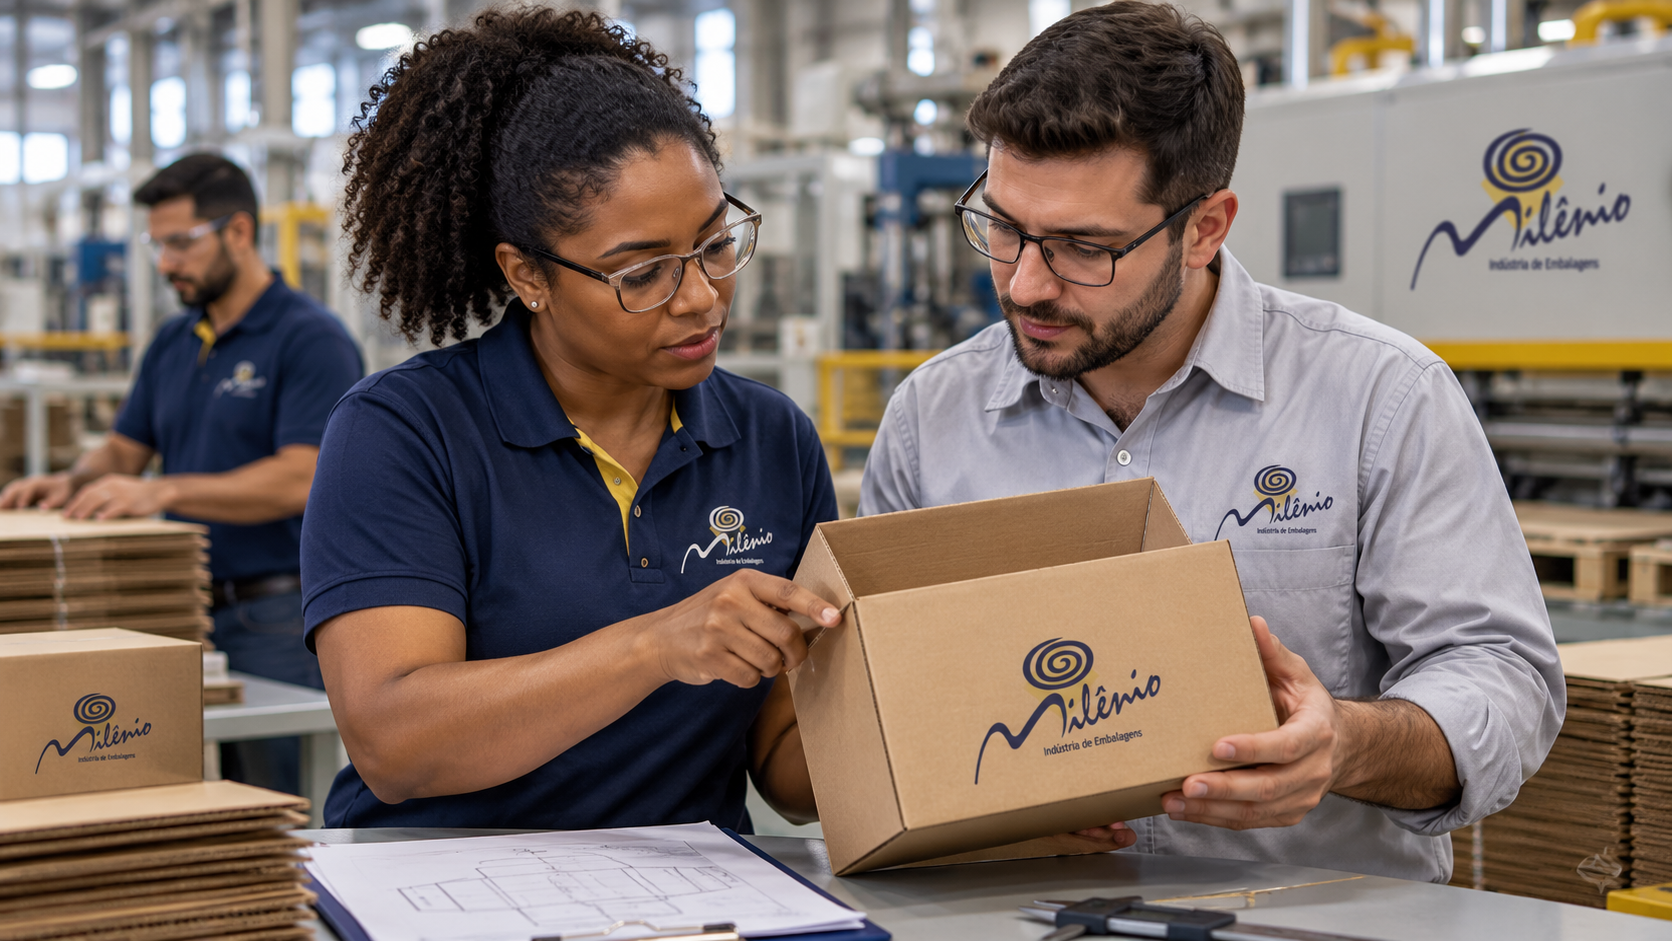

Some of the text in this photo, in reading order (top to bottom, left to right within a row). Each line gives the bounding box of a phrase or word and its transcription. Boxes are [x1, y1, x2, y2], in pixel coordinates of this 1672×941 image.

[1410, 183, 1631, 291] Milênio
[1489, 256, 1600, 273] Indústria de Embalagens
[1213, 491, 1334, 541] Milênio
[680, 528, 773, 574] Milênio
[34, 717, 152, 775] Milênio
[974, 669, 1161, 785] Milênio
[1043, 729, 1143, 756] Indústria de Embalagens
